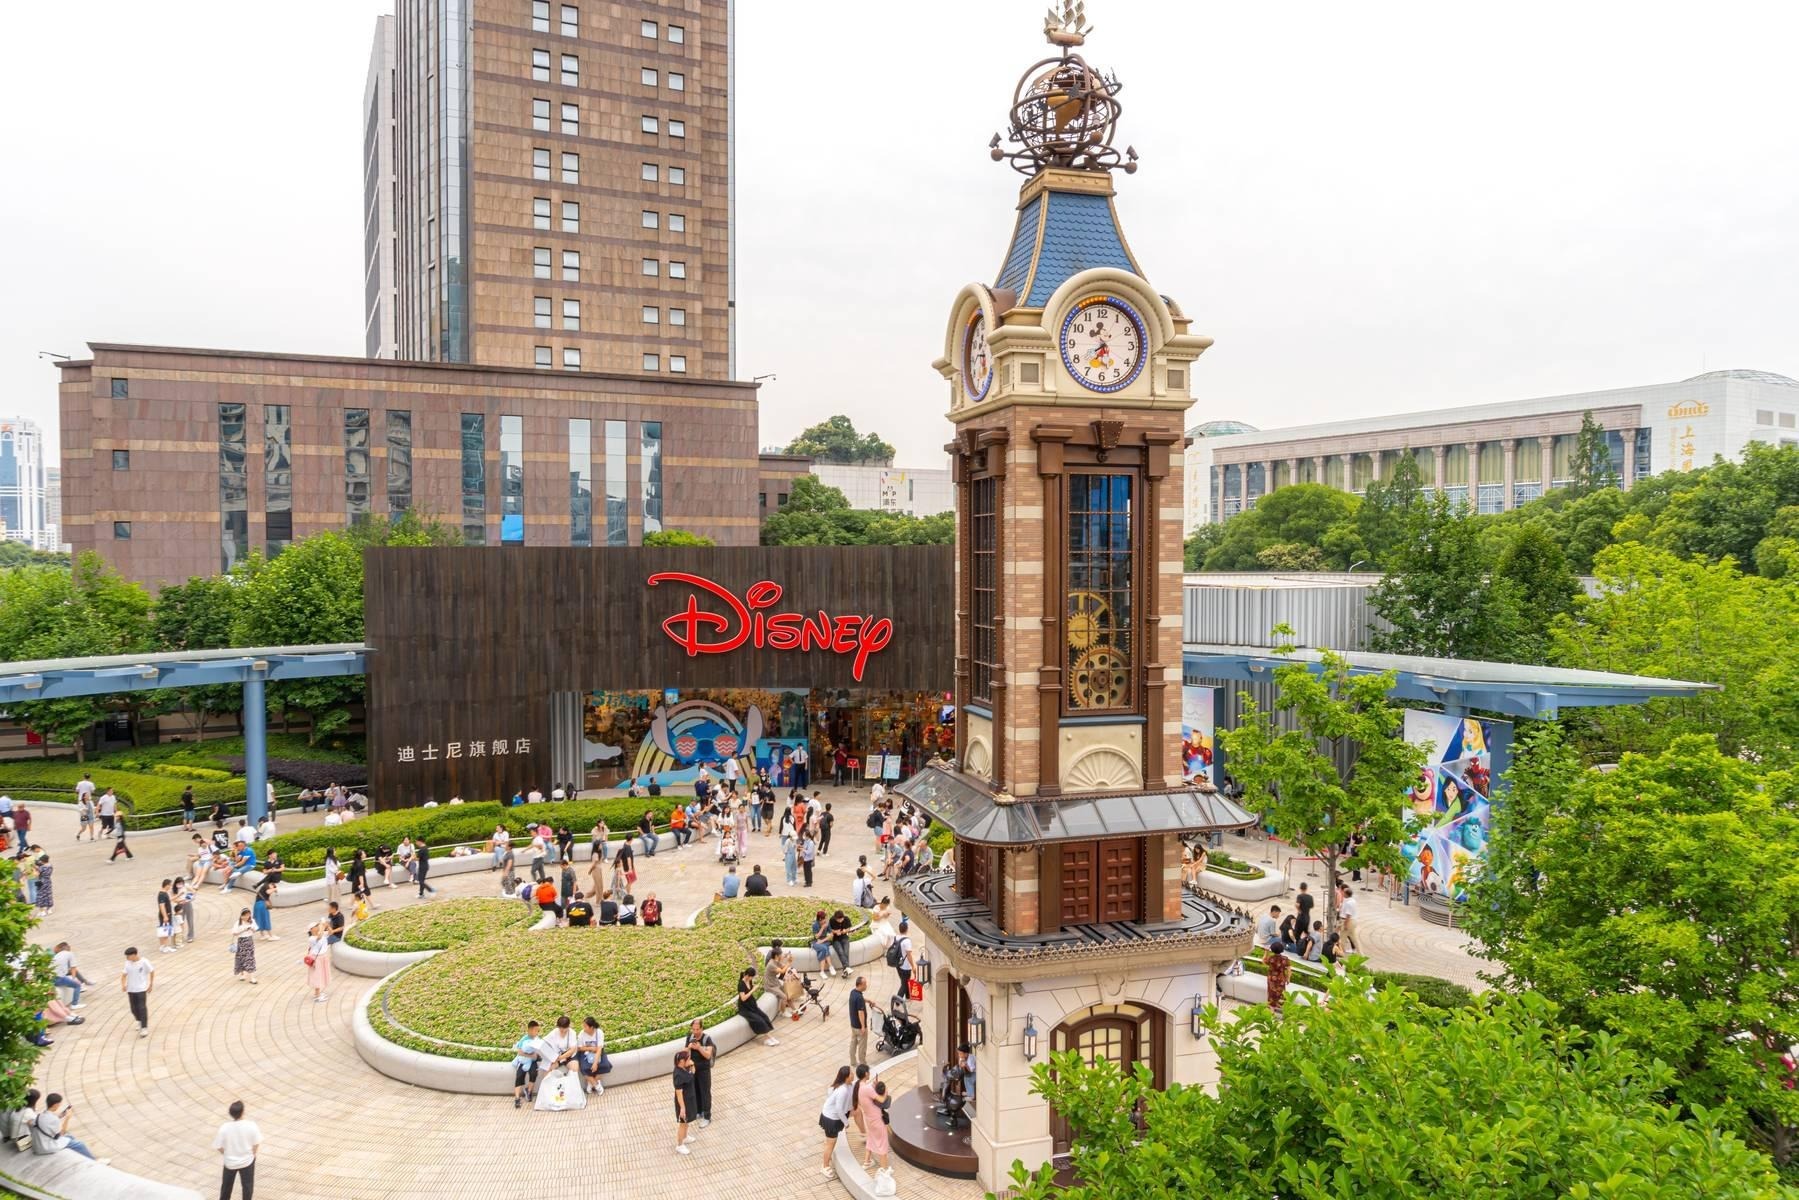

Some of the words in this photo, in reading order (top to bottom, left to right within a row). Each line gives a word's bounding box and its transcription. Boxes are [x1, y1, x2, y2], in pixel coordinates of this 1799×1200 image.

[1084, 312, 1092, 322] 11
[1097, 309, 1108, 319] 12
[1073, 324, 1084, 333] 10
[1124, 326, 1131, 336] 2
[1069, 340, 1075, 349] 9
[1127, 341, 1135, 351] 3
[1073, 354, 1080, 364] 8
[1123, 358, 1131, 367] 4
[1084, 367, 1091, 377] 7
[1098, 372, 1105, 381] 6
[1113, 368, 1120, 378] 5
[648, 572, 893, 682] Disney
[398, 738, 531, 762] 迪士尼旗舰店
